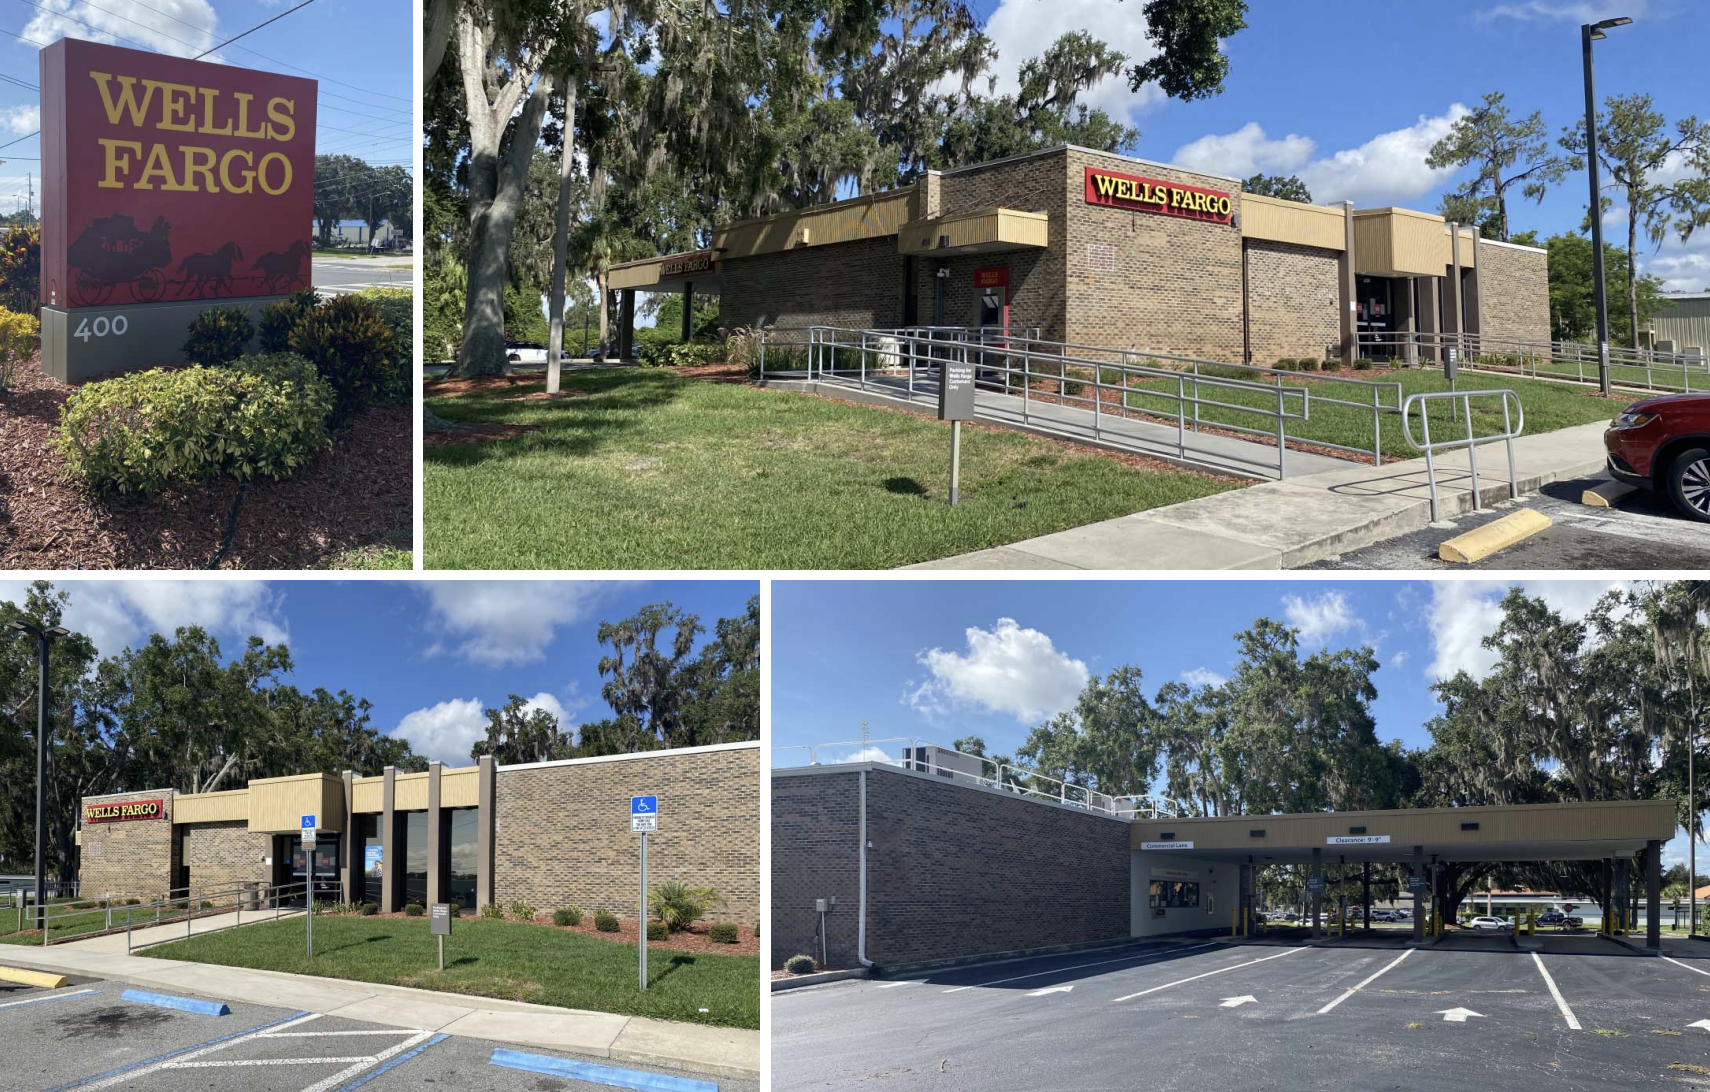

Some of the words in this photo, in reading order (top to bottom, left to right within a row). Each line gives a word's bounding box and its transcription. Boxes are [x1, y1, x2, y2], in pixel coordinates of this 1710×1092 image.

[90, 71, 296, 141] WELLS
[98, 138, 293, 195] FARGO
[1095, 174, 1167, 205] WELLS
[1171, 188, 1231, 215] FARGO
[660, 262, 683, 275] WELLS
[684, 258, 709, 272] FARGO
[74, 315, 128, 343] 400
[86, 806, 119, 818] WELLS
[121, 803, 157, 816] FARGO
